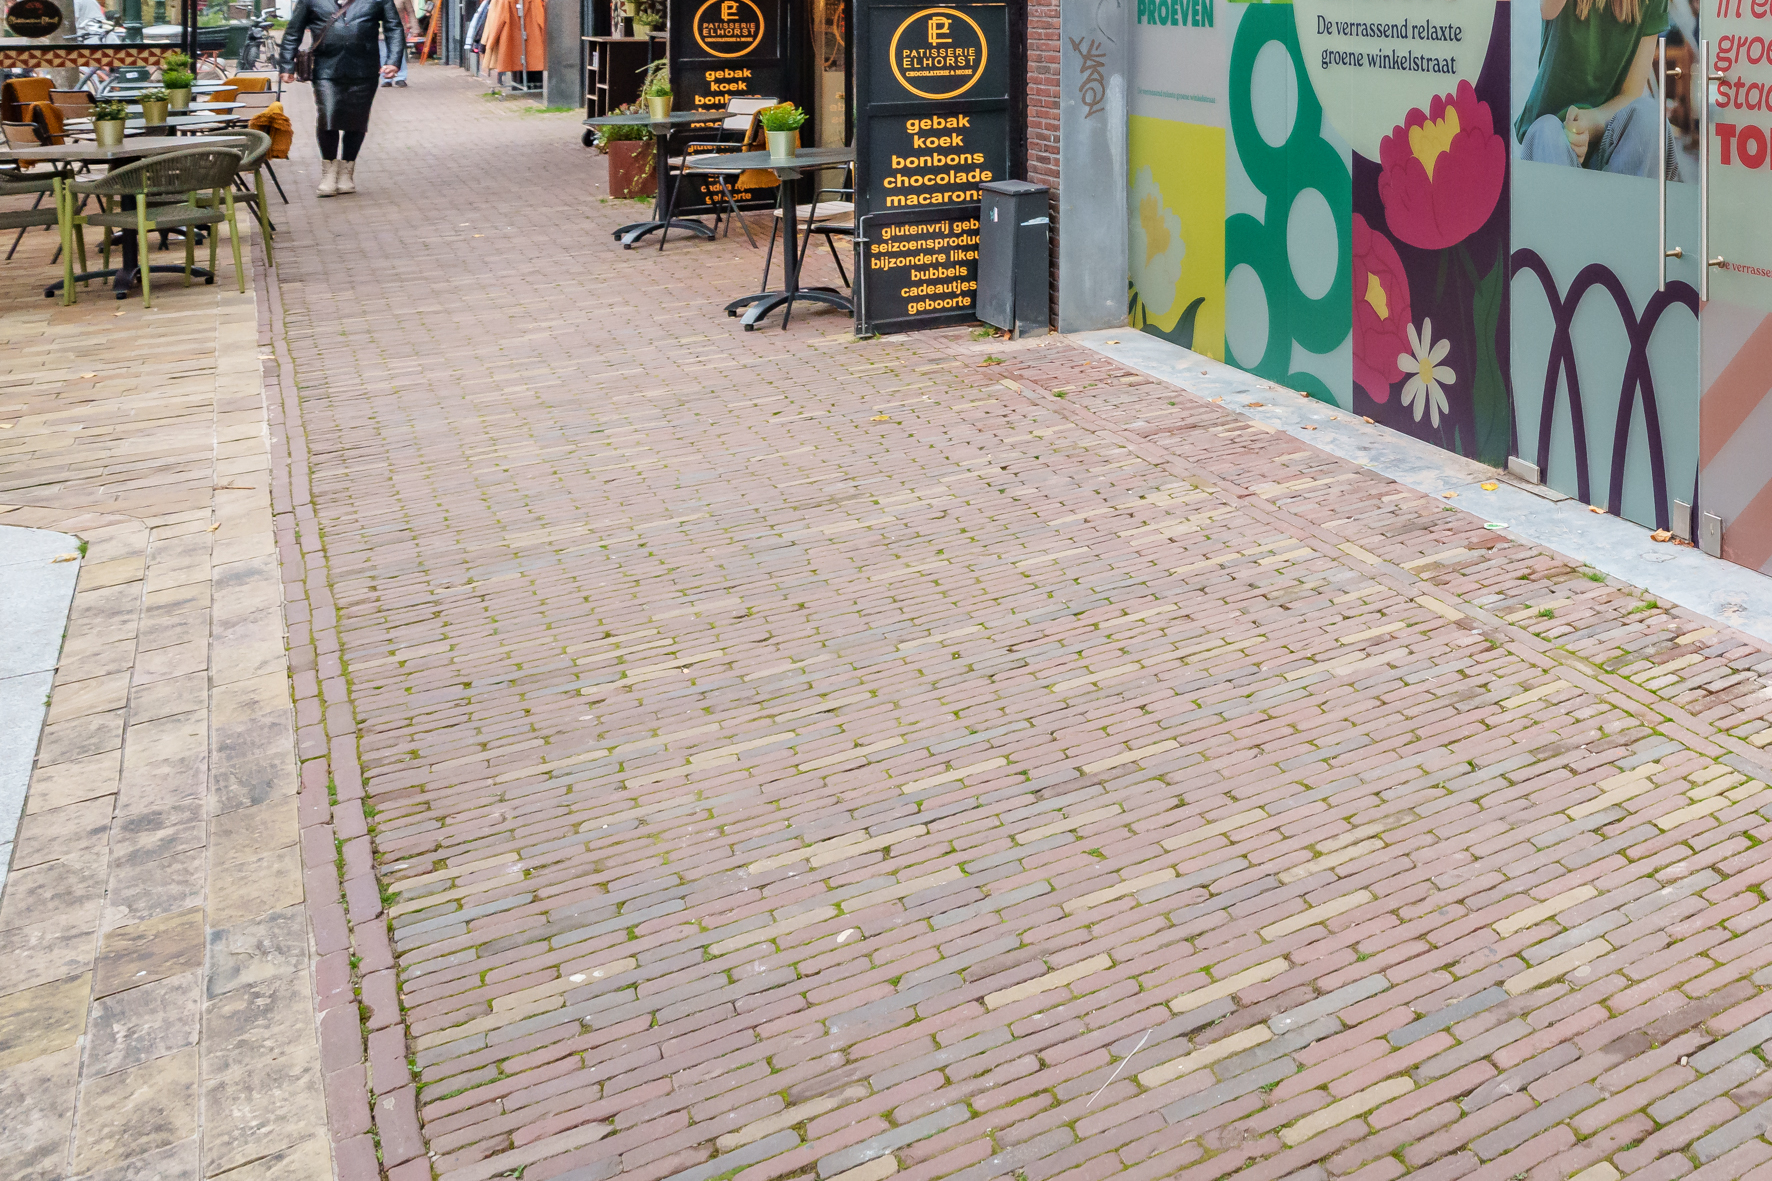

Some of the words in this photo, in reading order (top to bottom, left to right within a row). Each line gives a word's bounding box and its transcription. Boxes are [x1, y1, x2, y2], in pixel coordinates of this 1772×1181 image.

[703, 28, 755, 36] ELHORST
[1317, 15, 1332, 35] De
[1335, 18, 1408, 39] verrassend
[1411, 18, 1462, 42] relaxte
[903, 48, 976, 58] PATISSERIE
[1321, 48, 1364, 69] groene
[1367, 48, 1456, 75] winkelstraat
[903, 56, 976, 68] ELHORST
[705, 68, 752, 81] gebak
[710, 81, 747, 91] koek
[906, 114, 970, 134] gebak
[913, 133, 964, 149] koek
[891, 152, 984, 169] bonbons
[883, 168, 993, 188] chocolade
[881, 221, 949, 239] glutenvrij
[953, 218, 981, 233] geb
[871, 252, 946, 270] bijzondere
[911, 265, 967, 281] bubbels
[901, 280, 977, 297] cadeautjes
[908, 295, 971, 314] geboorte
